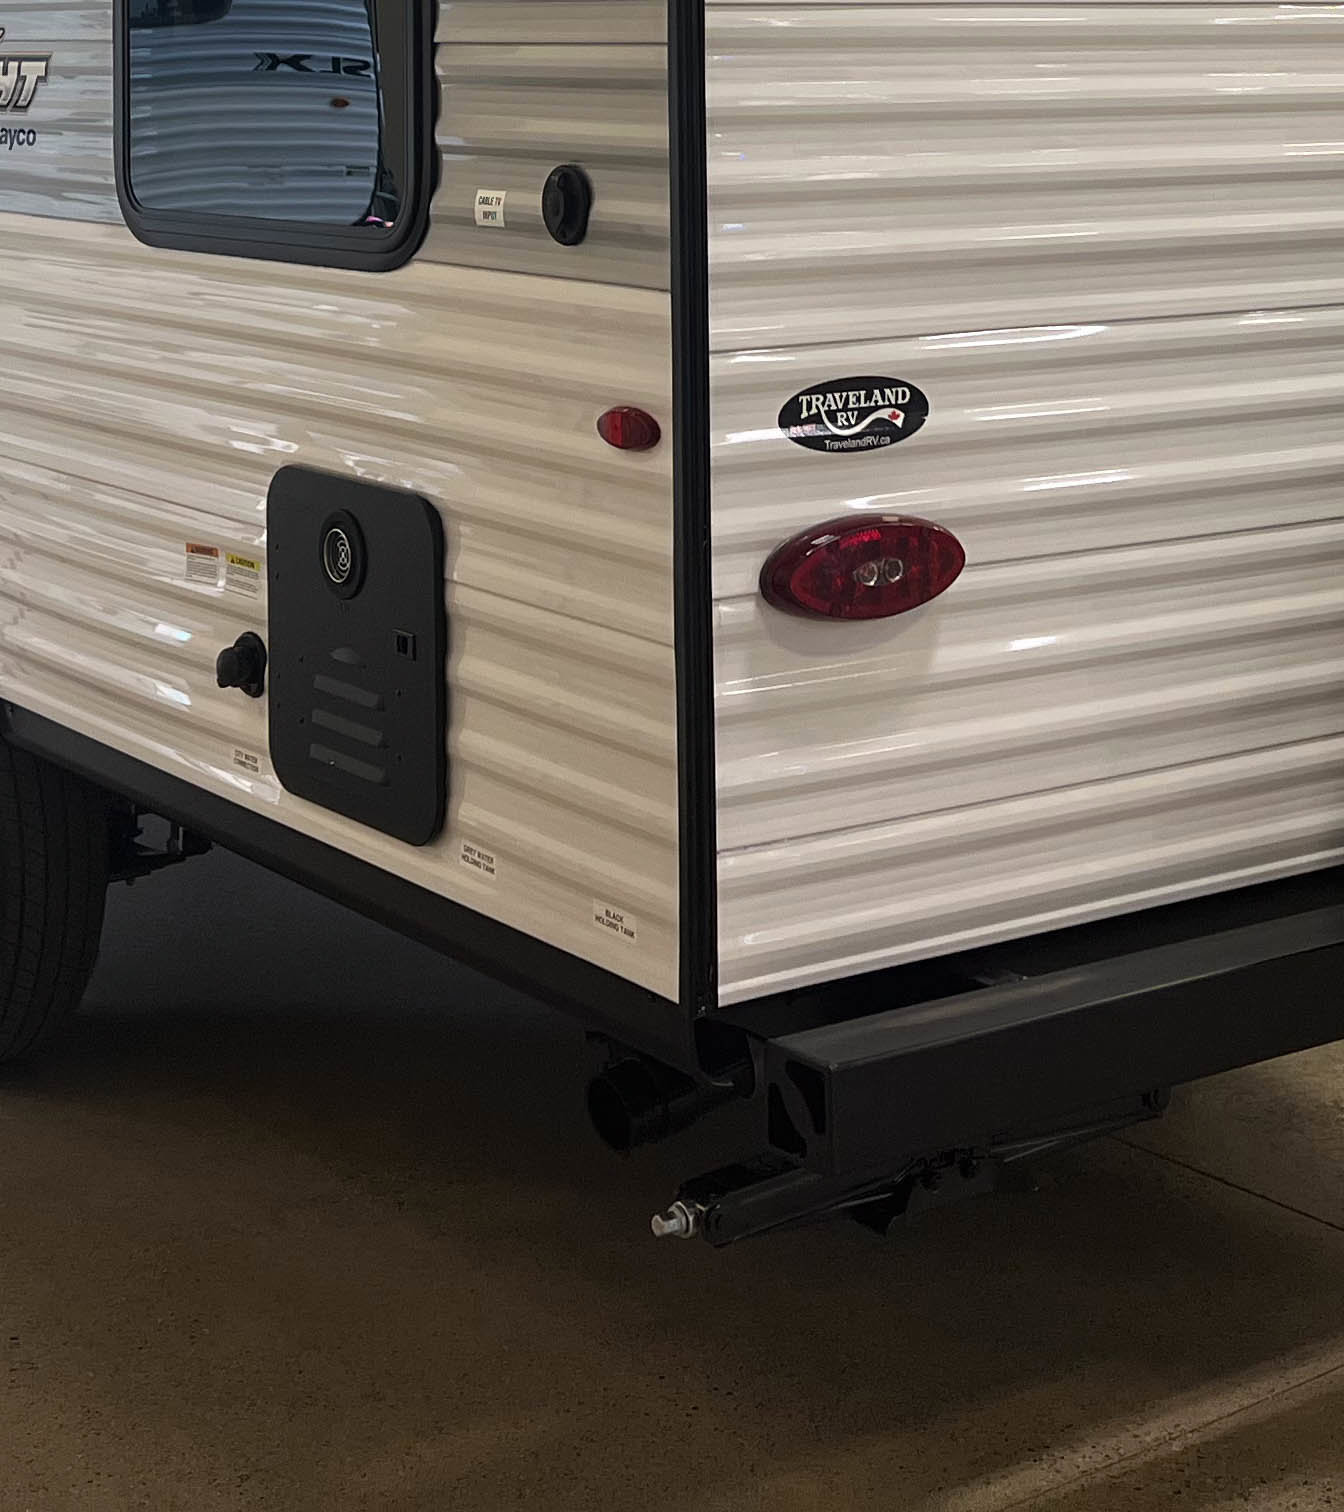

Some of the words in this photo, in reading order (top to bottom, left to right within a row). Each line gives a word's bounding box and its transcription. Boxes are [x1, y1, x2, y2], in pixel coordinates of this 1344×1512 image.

[798, 387, 911, 419] TRAVELAND
[836, 410, 859, 427] RV
[824, 435, 891, 450] TravelandRV.ca
[605, 908, 624, 924] BLACK
